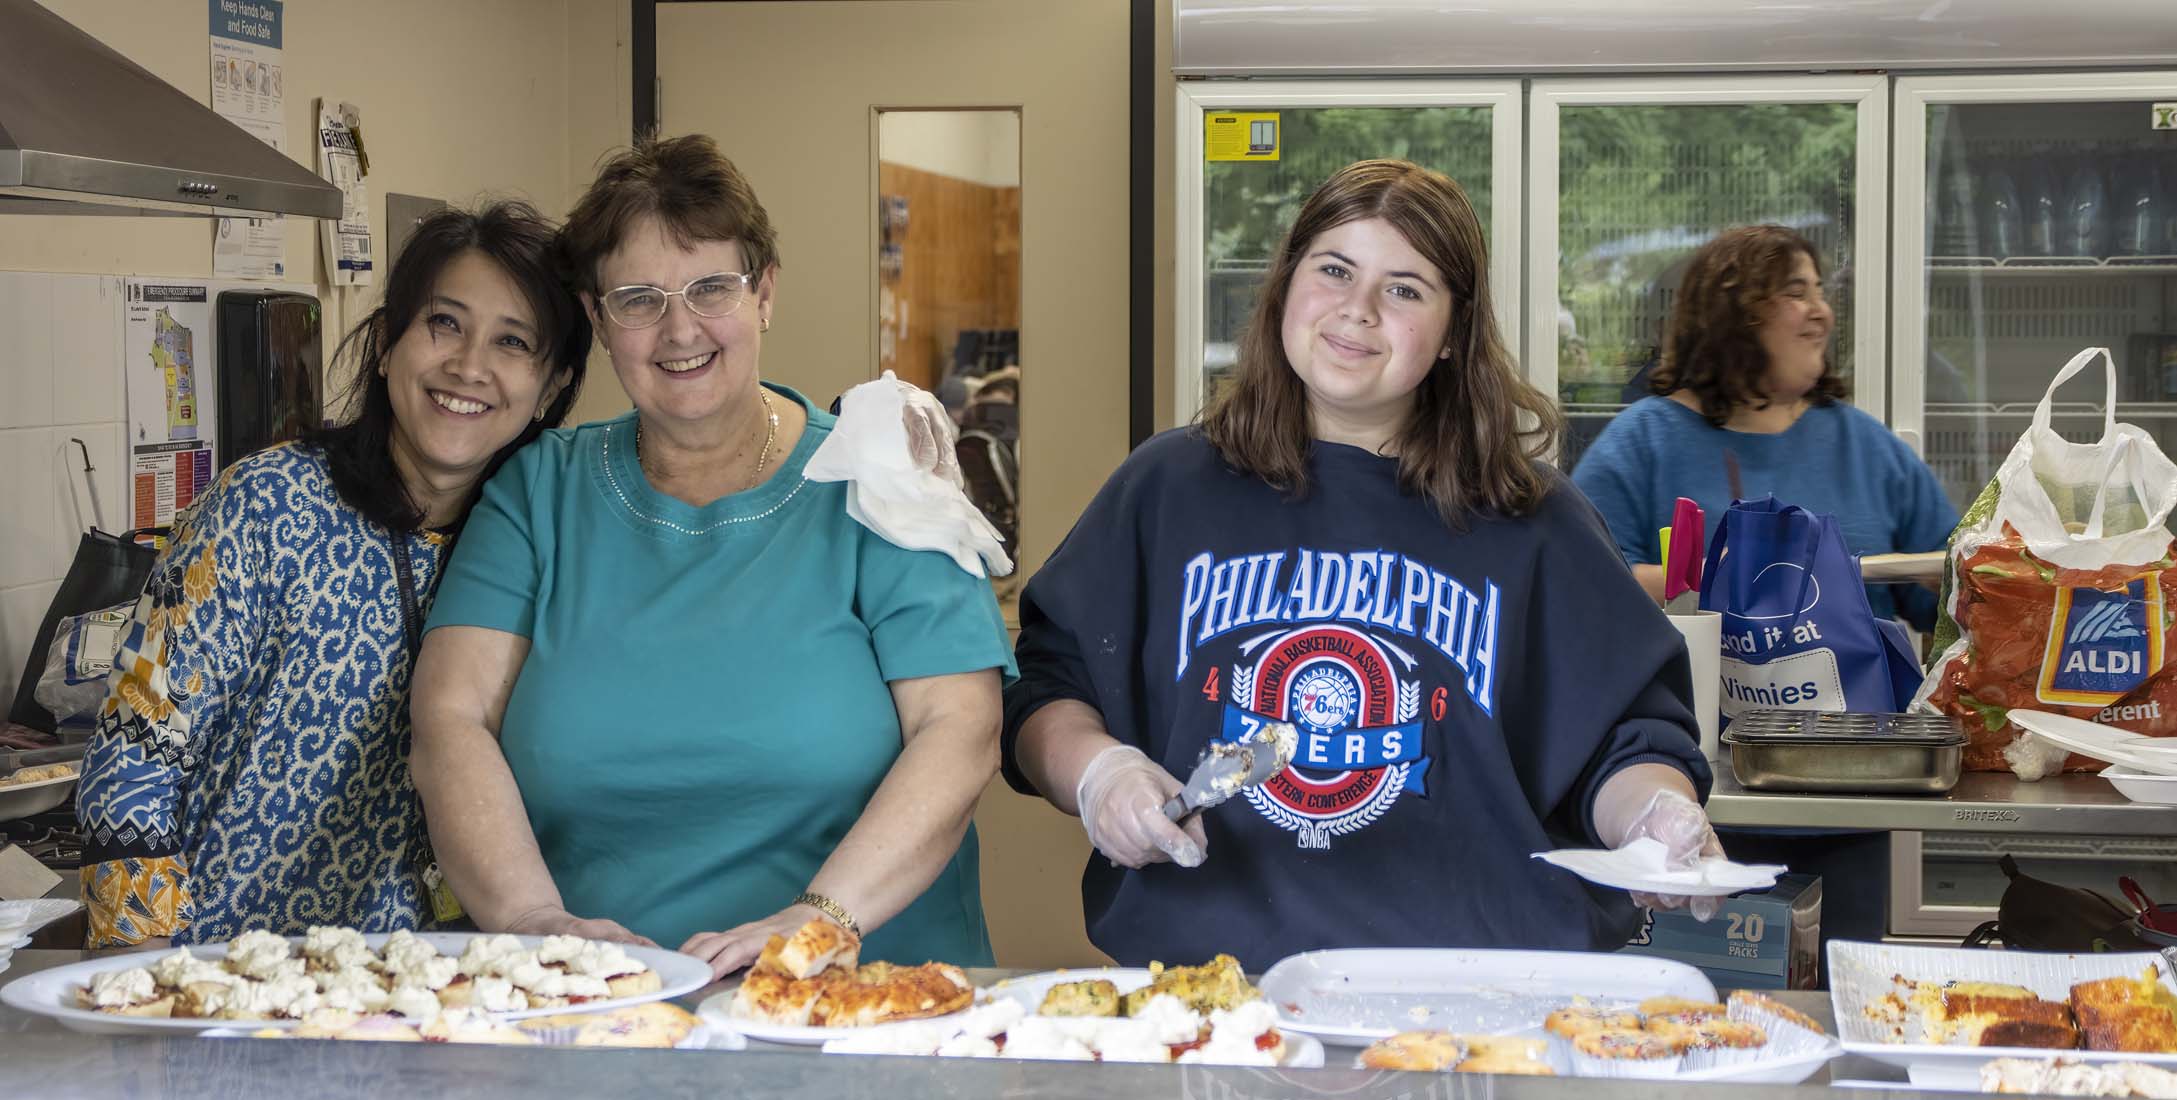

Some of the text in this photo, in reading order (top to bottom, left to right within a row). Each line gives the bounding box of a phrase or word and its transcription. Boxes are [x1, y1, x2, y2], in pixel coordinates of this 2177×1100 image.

[221, 0, 238, 16] Keep
[239, 1, 259, 18] Hands
[228, 19, 271, 40] and Food Safe
[1177, 549, 1499, 717] PHILADELPHIA
[1793, 620, 1822, 645] at
[2064, 650, 2141, 674] ALDI
[1202, 667, 1219, 701] 4
[1261, 636, 1386, 724] NATIONAL BASKETBALL ASSOCIATION
[1292, 667, 1357, 704] PHILADELPHIA
[1720, 676, 1818, 706] Vinnies
[1303, 693, 1344, 715] 76ers
[1431, 687, 1447, 720] 6
[2093, 700, 2161, 723] erent
[1238, 715, 1402, 764] 7ERS
[1270, 771, 1377, 808] STERN CONFERENCE
[1955, 808, 2008, 822] BRITEX
[1308, 828, 1330, 850] NBA
[1727, 913, 1764, 943] 20
[1728, 946, 1759, 959] PACKS
